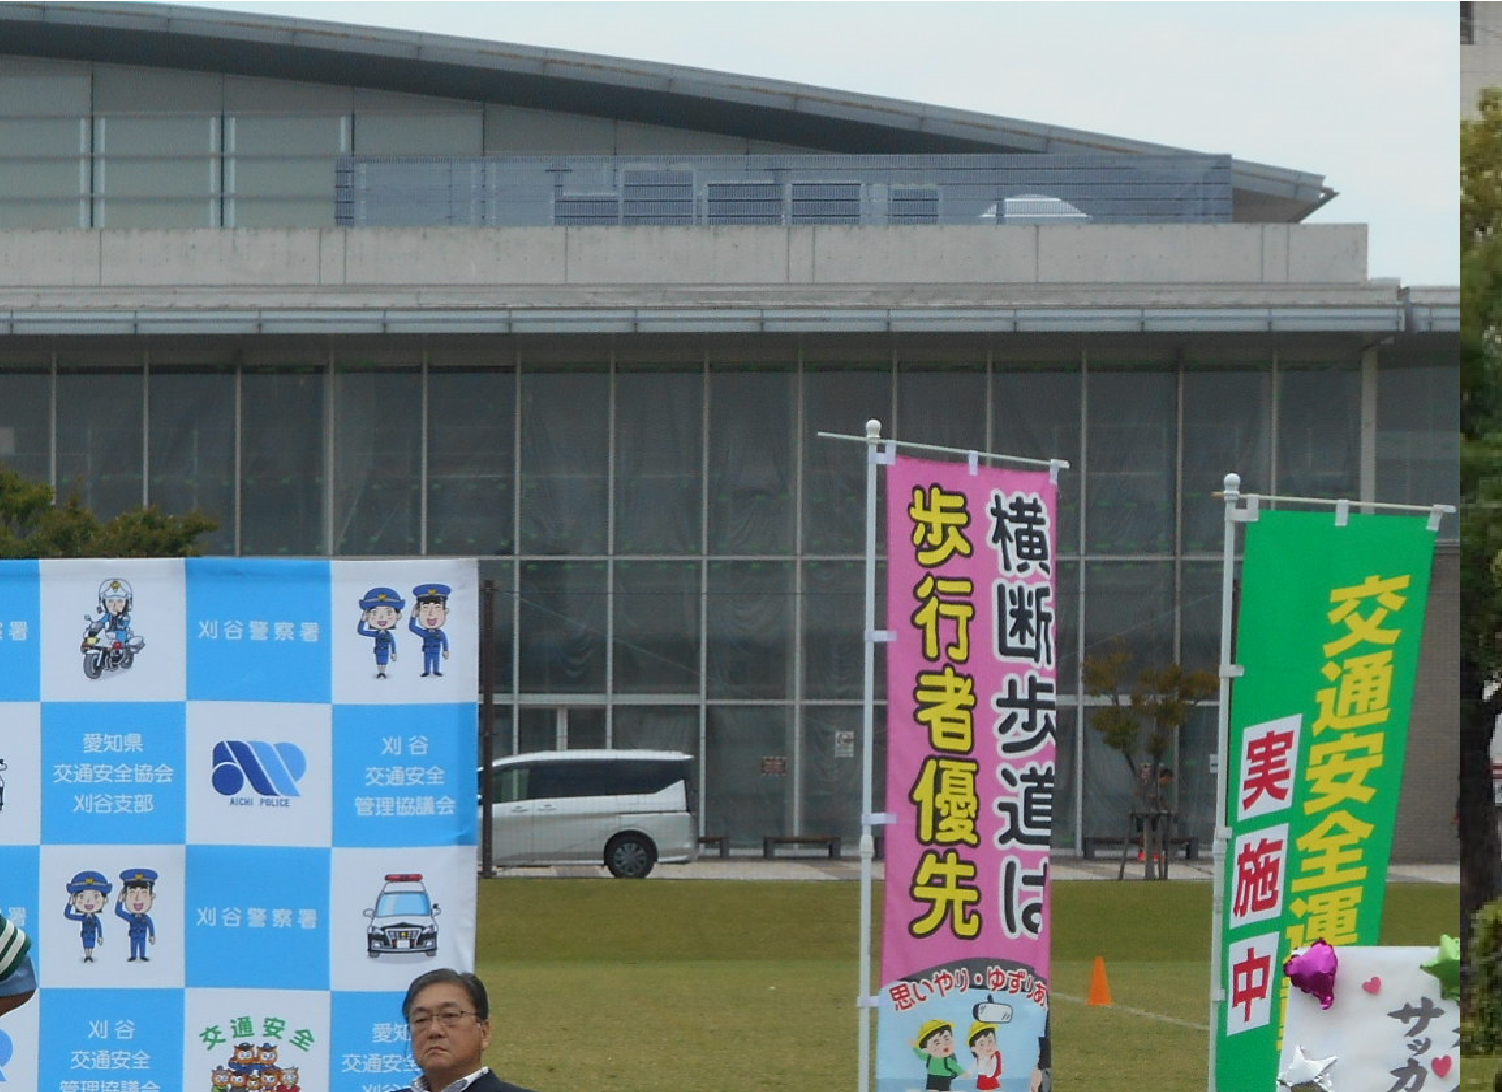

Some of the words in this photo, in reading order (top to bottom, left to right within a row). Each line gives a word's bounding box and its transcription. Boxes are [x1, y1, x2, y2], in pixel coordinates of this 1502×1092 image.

[199, 620, 319, 642] 刈谷警察署
[909, 484, 981, 940] 歩行者優先
[990, 489, 1057, 938] 横断歩道は
[83, 734, 143, 752] 愛知県
[383, 736, 429, 755] 刈谷
[53, 764, 173, 783] 交通安全協会
[365, 766, 445, 786] 交通安全
[73, 794, 153, 814] 刈谷支部
[229, 798, 255, 806] AICHI
[260, 798, 290, 808] POLICE
[355, 796, 455, 816] 管理協議会
[1279, 573, 1411, 1050] 交通安全運
[1232, 731, 1295, 1022] 実施中
[197, 907, 317, 929] 刈谷警察署
[88, 1020, 135, 1039] 刈谷
[200, 1016, 315, 1051] 交通安全
[71, 1050, 149, 1069] 交通安全
